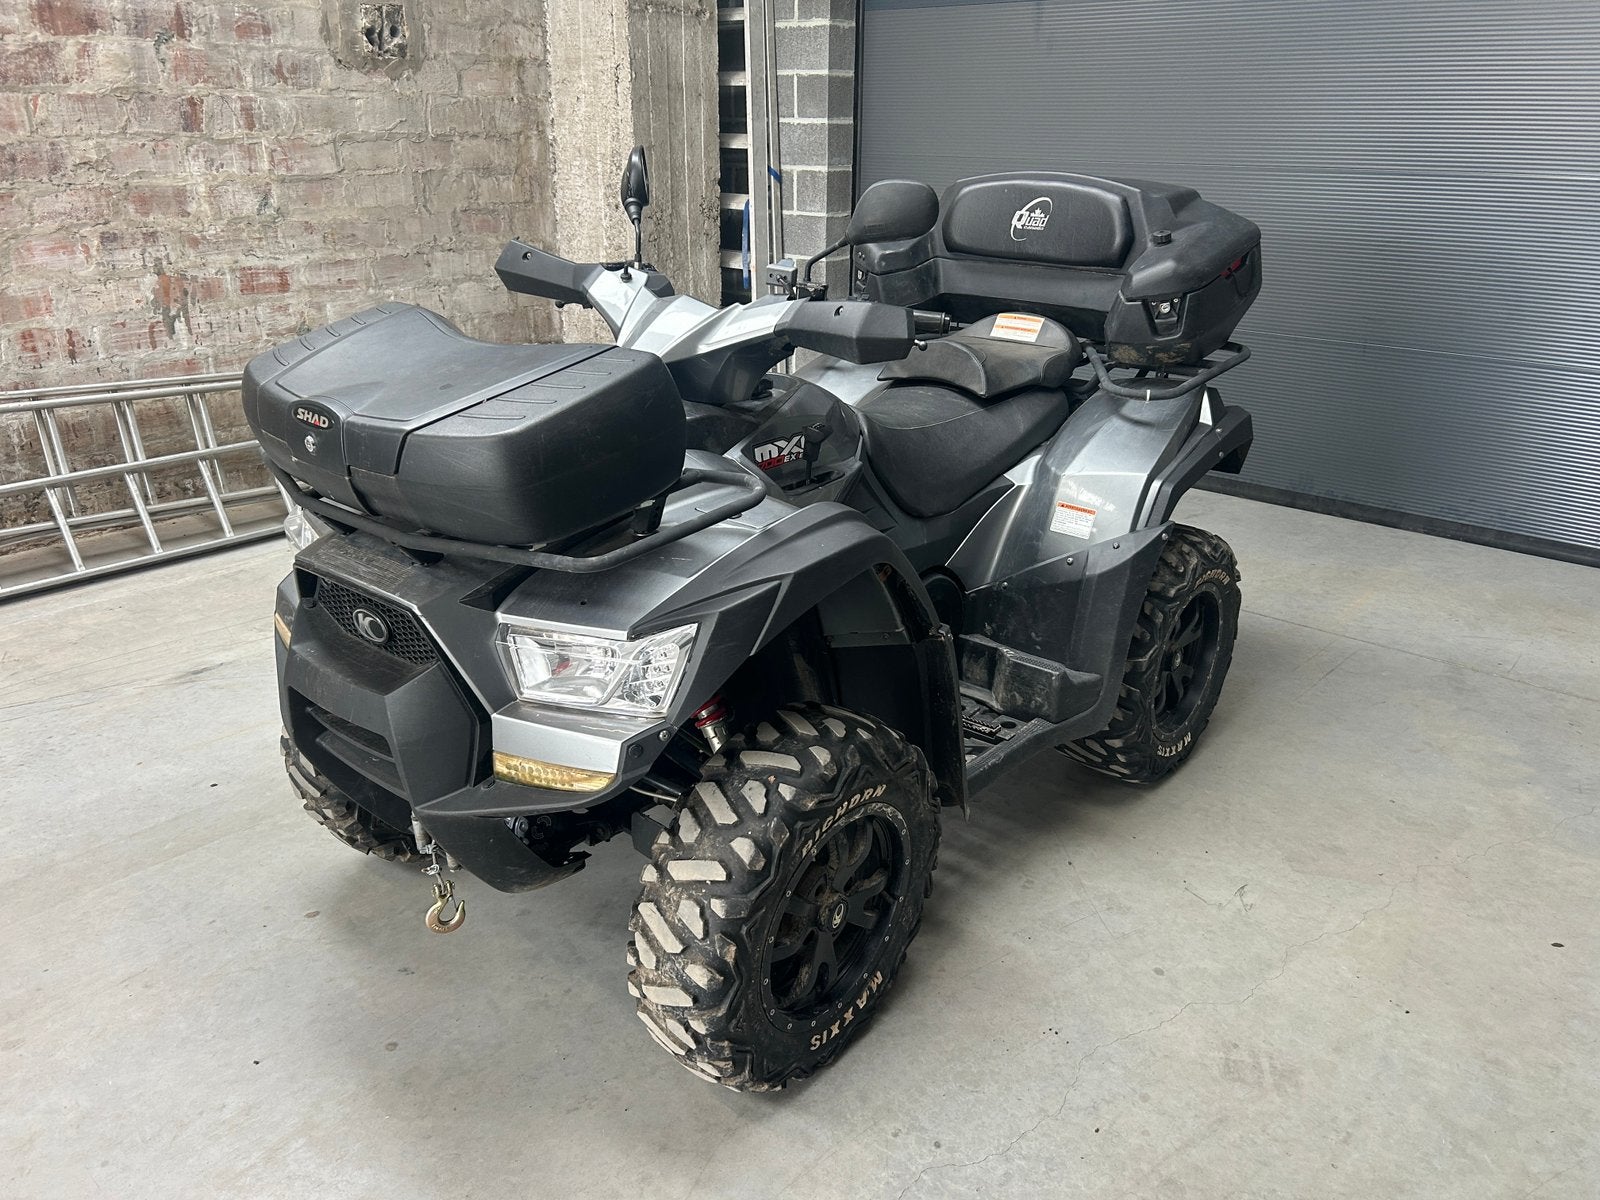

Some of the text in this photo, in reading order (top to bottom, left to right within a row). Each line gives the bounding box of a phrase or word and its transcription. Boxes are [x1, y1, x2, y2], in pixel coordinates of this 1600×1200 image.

[1011, 210, 1050, 229] Quad
[296, 407, 329, 428] SHAD
[1156, 731, 1191, 757] MAXXIS
[802, 784, 887, 859] BIGHORN
[810, 970, 883, 1051] MAXXIS
